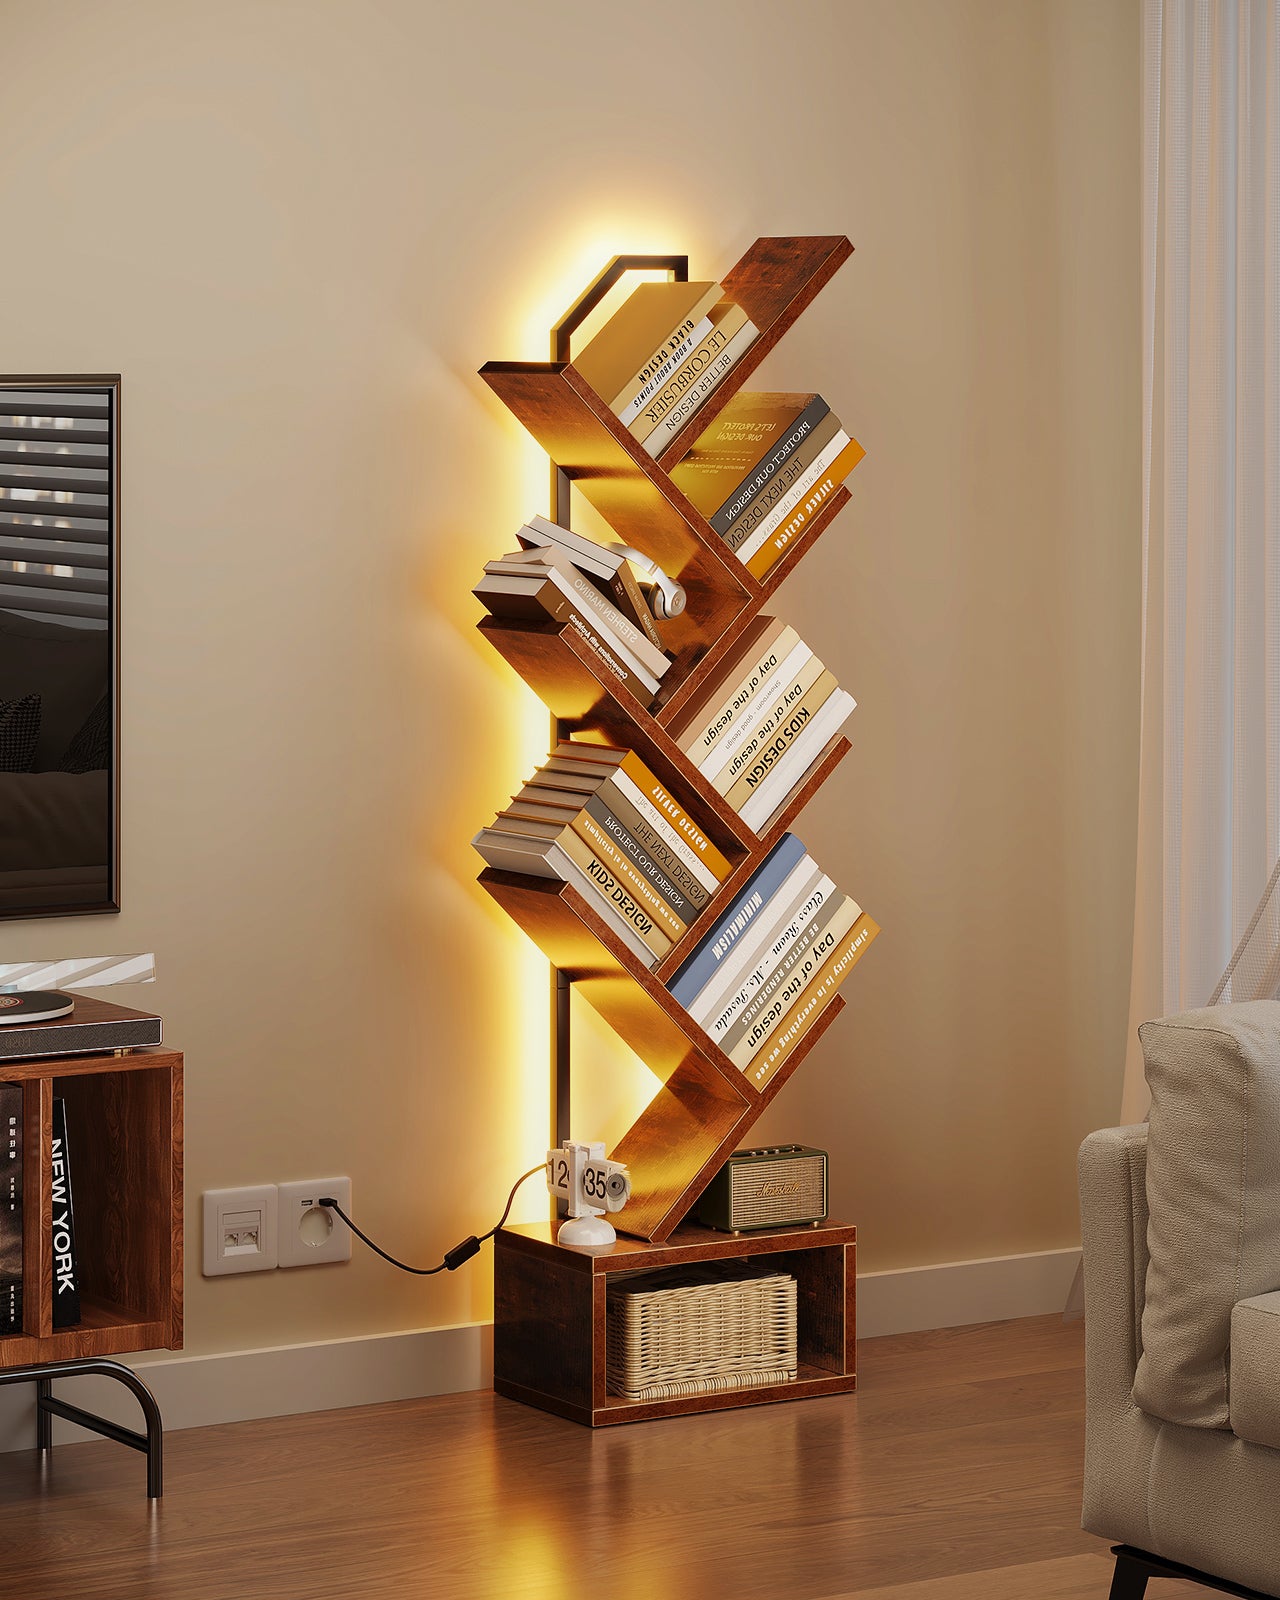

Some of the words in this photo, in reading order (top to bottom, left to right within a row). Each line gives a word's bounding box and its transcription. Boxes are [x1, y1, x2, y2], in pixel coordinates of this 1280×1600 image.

[667, 319, 695, 350] BLACK
[686, 337, 693, 346] A
[707, 329, 727, 352] LE
[638, 349, 669, 385] DESIGN
[671, 343, 688, 364] BOOK
[644, 349, 711, 423] CORBUSIER
[653, 361, 672, 385] ABOUT
[698, 354, 732, 392] BETTER
[633, 382, 655, 408] POINTS
[665, 390, 701, 431] DESIGN
[758, 654, 778, 678] Day
[732, 689, 750, 710] the
[748, 677, 759, 694] of
[755, 679, 782, 711] Showroom
[783, 683, 803, 708] Day
[703, 709, 733, 746] design
[740, 714, 754, 731] good
[757, 719, 775, 739] the
[773, 706, 784, 724] of
[783, 707, 811, 741] KIDS
[725, 729, 742, 750] design
[729, 738, 759, 776] design
[745, 737, 787, 788] DESIGN
[799, 891, 824, 921] Class
[711, 891, 763, 961] MINIMALISM
[772, 921, 800, 955] Room
[808, 922, 819, 938] BE
[783, 935, 810, 969] BETTER
[812, 932, 835, 962] Day
[833, 928, 868, 976] simplicity
[800, 961, 813, 981] of
[825, 975, 835, 986] is
[741, 968, 785, 1026] RENDERINGS
[781, 977, 802, 1002] the
[816, 985, 827, 998] in
[715, 988, 749, 1031] Posada
[747, 1001, 782, 1048] design
[778, 997, 818, 1048] everything
[768, 1047, 781, 1062] we
[755, 1061, 769, 1080] see
[585, 1167, 606, 1199] 35
[52, 1210, 75, 1295] YORK
